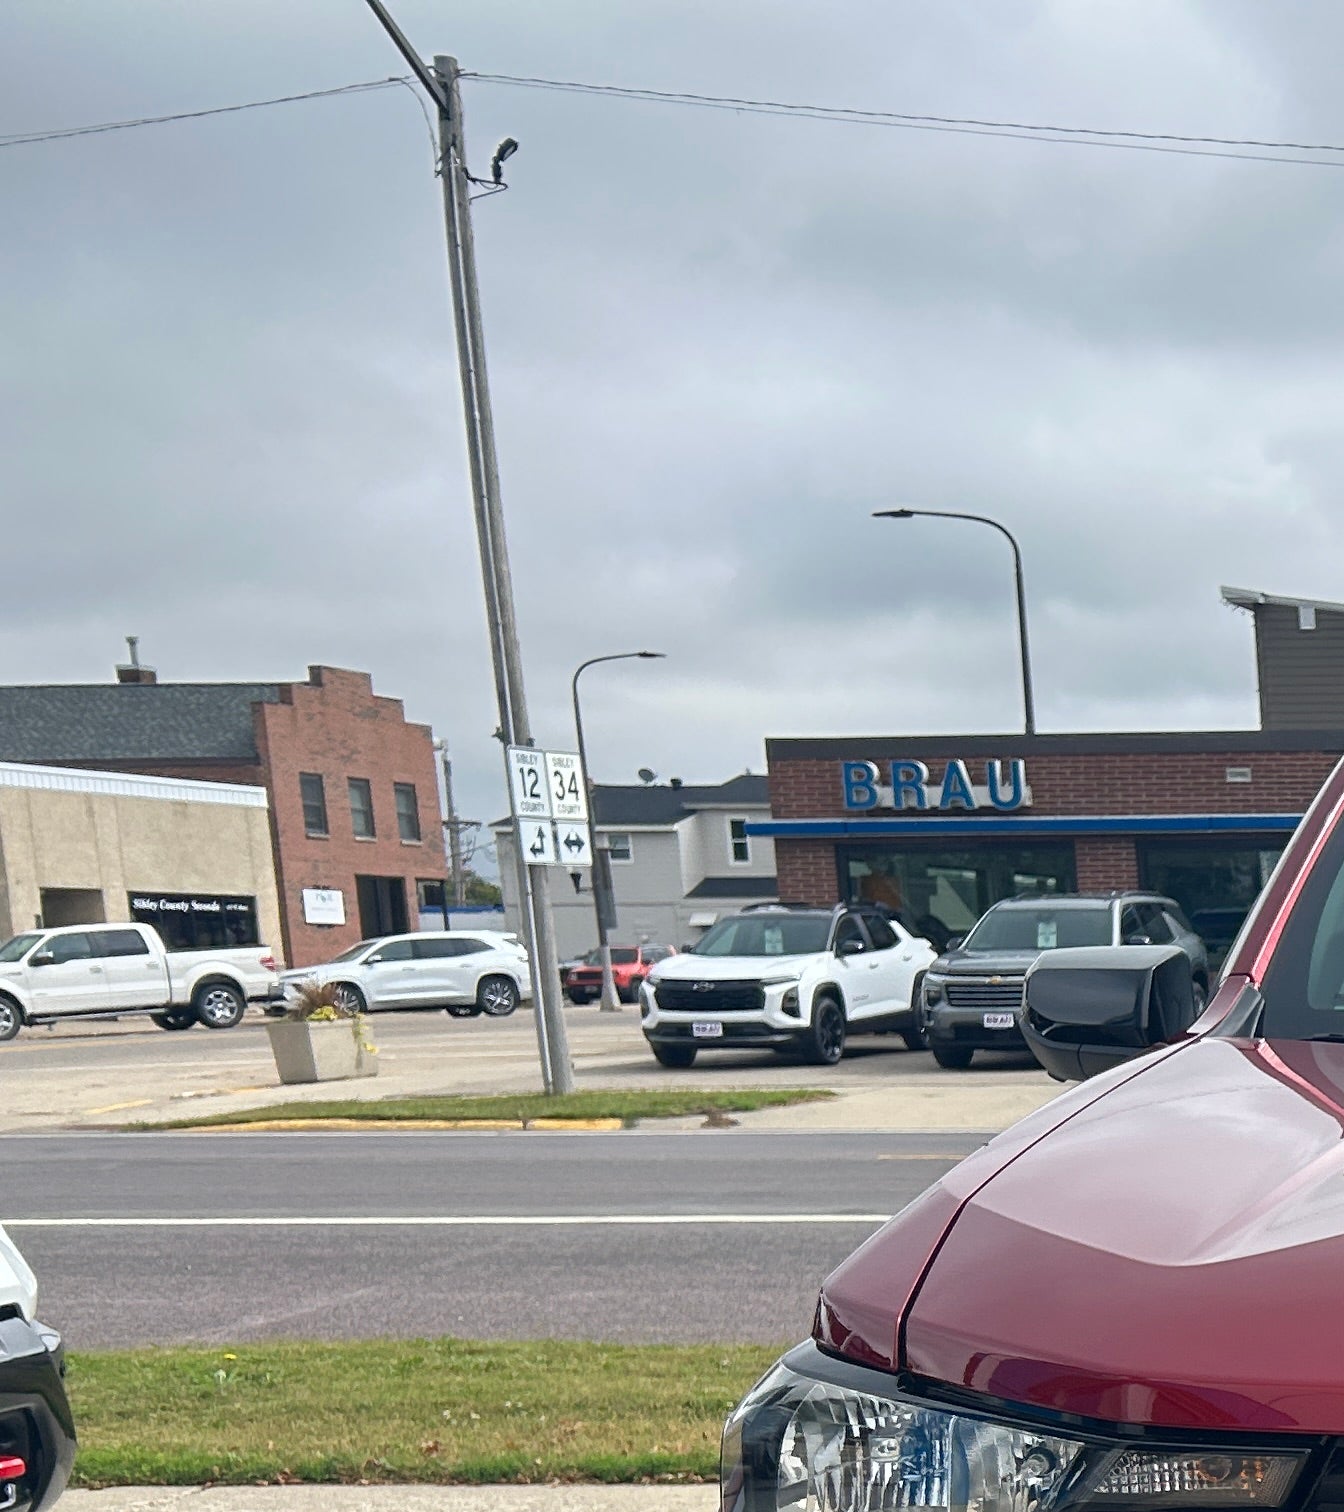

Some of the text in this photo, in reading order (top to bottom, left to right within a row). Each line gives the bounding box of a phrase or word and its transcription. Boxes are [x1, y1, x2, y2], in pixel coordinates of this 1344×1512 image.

[519, 767, 541, 799] 12
[553, 770, 579, 802] 34
[841, 758, 1026, 811] BRAU
[160, 898, 189, 912] County
